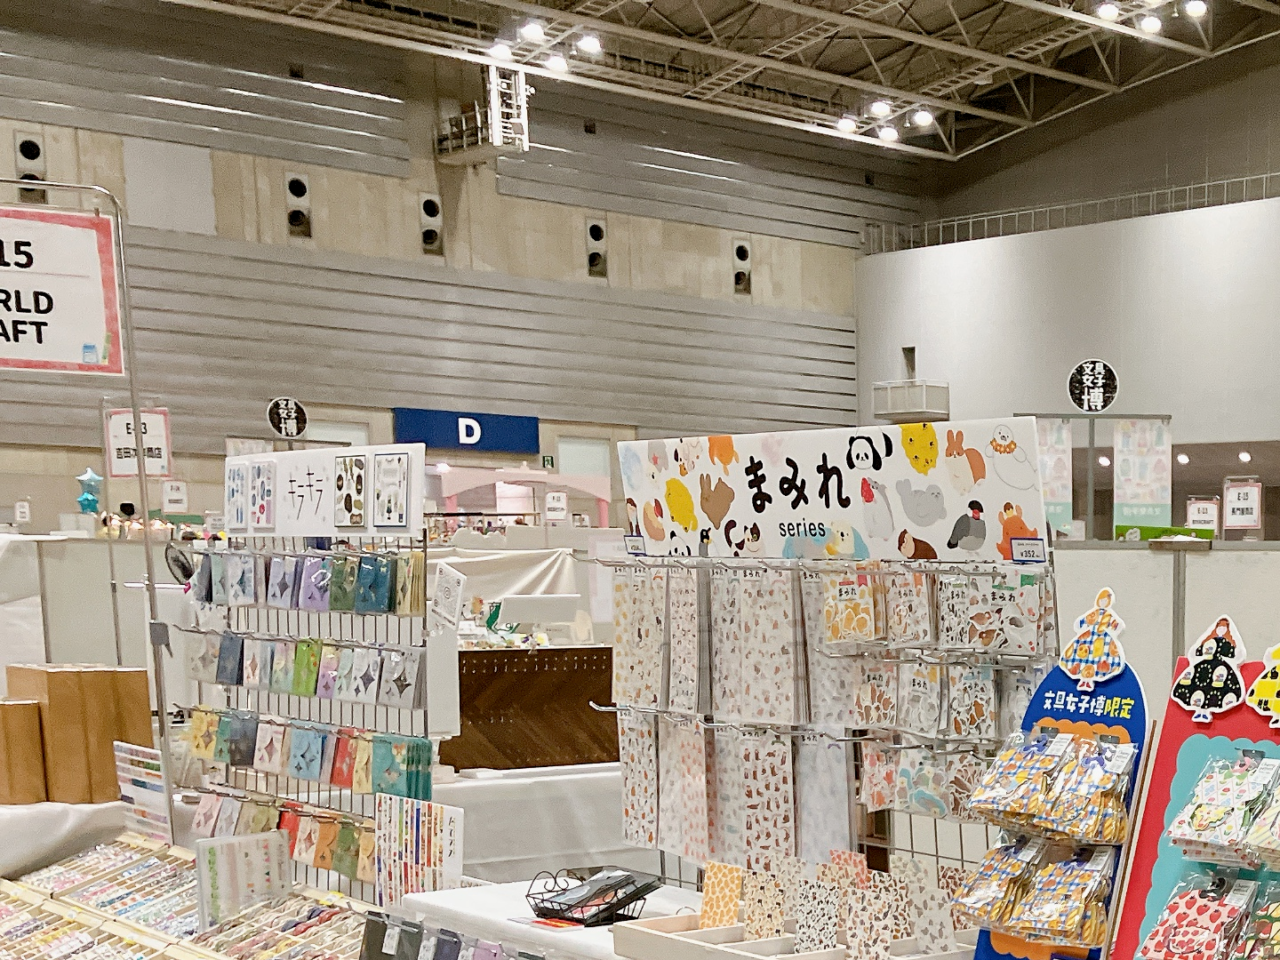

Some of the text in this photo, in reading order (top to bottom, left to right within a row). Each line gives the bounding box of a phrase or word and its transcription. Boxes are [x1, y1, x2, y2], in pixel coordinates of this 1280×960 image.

[126, 423, 148, 435] E-3
[458, 417, 482, 444] D
[744, 453, 850, 513] まみれ
[779, 521, 826, 538] series
[1043, 690, 1135, 719] 文具女子博限定
